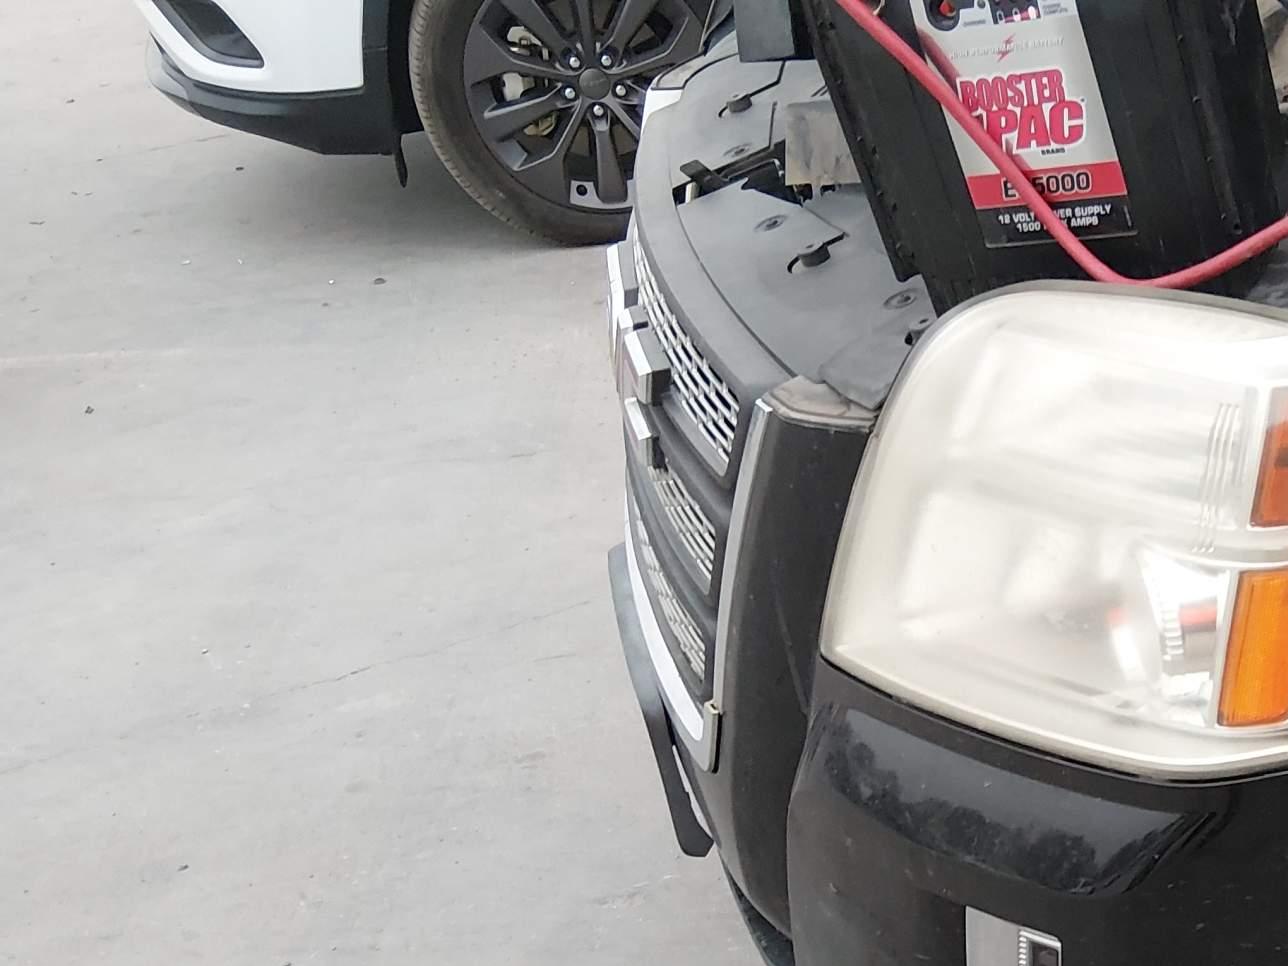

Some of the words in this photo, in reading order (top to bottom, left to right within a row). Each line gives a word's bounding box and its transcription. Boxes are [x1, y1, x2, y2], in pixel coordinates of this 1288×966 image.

[959, 69, 1065, 112] BOOSTER
[985, 100, 1084, 150] PAC
[1002, 172, 1091, 199] E5000
[1071, 216, 1099, 228] AMPS
[1074, 203, 1112, 217] SUPPLY
